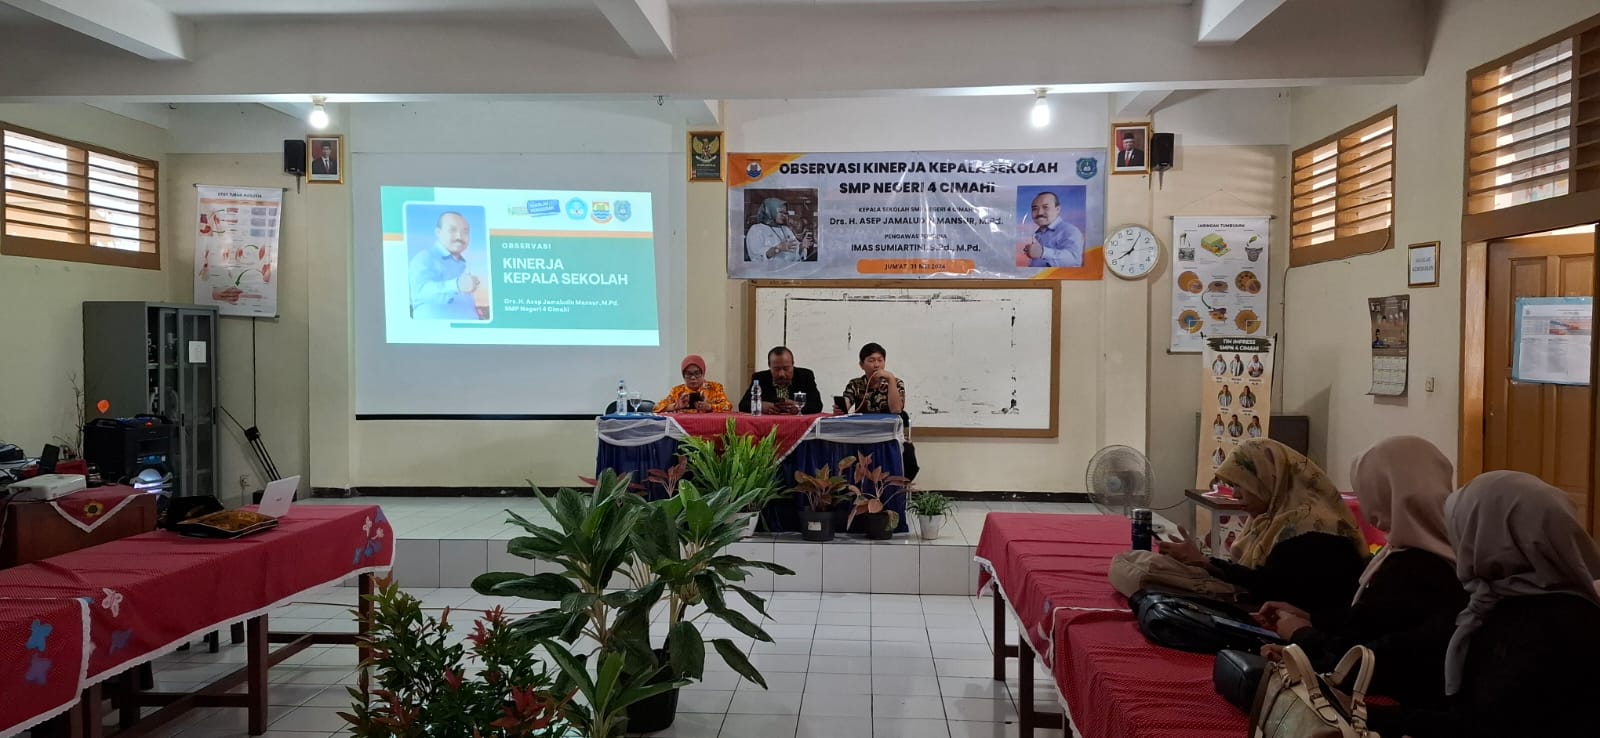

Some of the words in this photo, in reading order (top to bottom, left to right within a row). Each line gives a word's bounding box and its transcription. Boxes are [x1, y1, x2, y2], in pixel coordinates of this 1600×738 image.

[779, 162, 861, 175] OBSERVASI
[863, 162, 926, 174] KINERJA
[839, 182, 871, 194] SMP
[873, 182, 925, 194] NEGERI
[927, 182, 937, 193] 4
[939, 181, 996, 193] CIMAHI
[829, 217, 847, 225] Drs.
[849, 217, 858, 225] H.
[859, 217, 882, 225] ASEP
[501, 242, 552, 250] OBSERVASI
[851, 244, 873, 252] IMAS
[956, 244, 981, 252] M.Pd.
[503, 257, 564, 270] KINERJA
[503, 272, 559, 284] KEPALA
[561, 273, 629, 285] SEKOLAH
